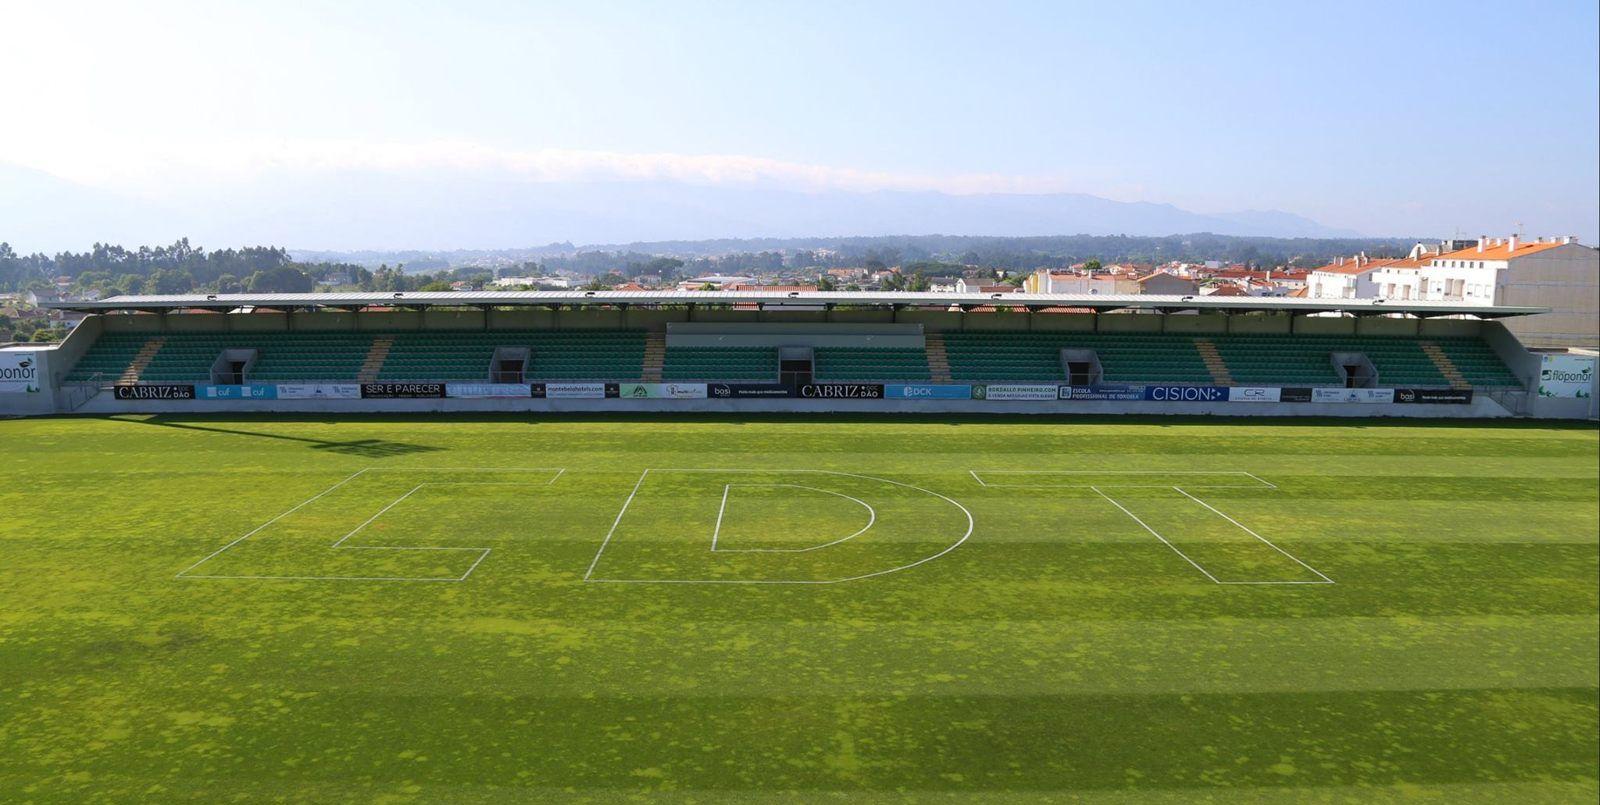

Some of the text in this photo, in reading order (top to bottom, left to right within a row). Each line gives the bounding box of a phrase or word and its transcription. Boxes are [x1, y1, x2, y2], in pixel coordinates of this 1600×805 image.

[119, 386, 172, 398] CABRIZ
[366, 384, 384, 393] SER
[387, 384, 392, 393] E
[395, 384, 440, 393] PARECER
[802, 385, 859, 398] CABRIZ
[913, 388, 932, 396] DCK
[1153, 387, 1210, 400] CISION
